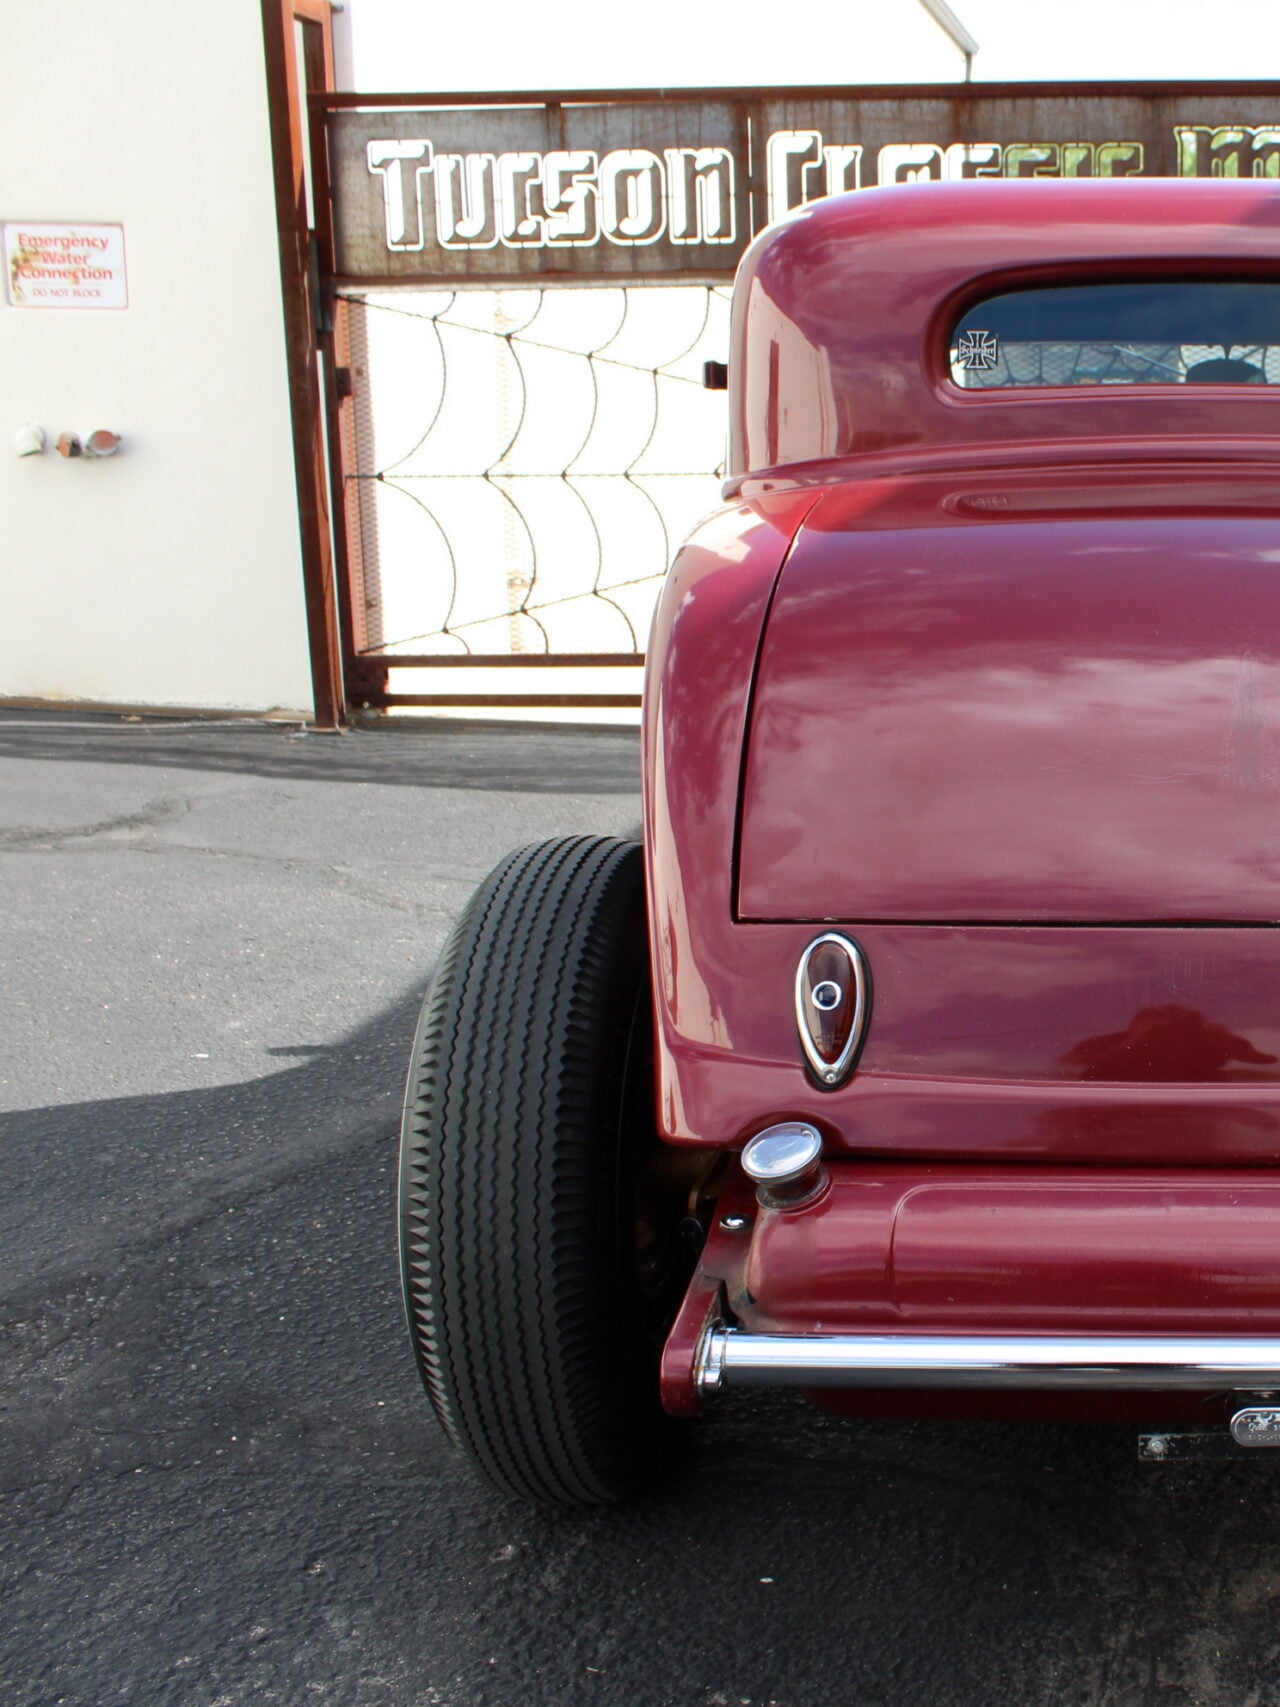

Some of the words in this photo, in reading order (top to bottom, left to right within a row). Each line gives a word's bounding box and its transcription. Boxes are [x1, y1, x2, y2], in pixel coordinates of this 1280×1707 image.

[367, 138, 736, 251] Tucson
[18, 233, 109, 251] Emergency
[41, 251, 89, 265] Water
[18, 264, 113, 280] Connection
[33, 288, 47, 297] DO
[50, 288, 69, 298] NOT
[73, 289, 103, 298] BLOCK
